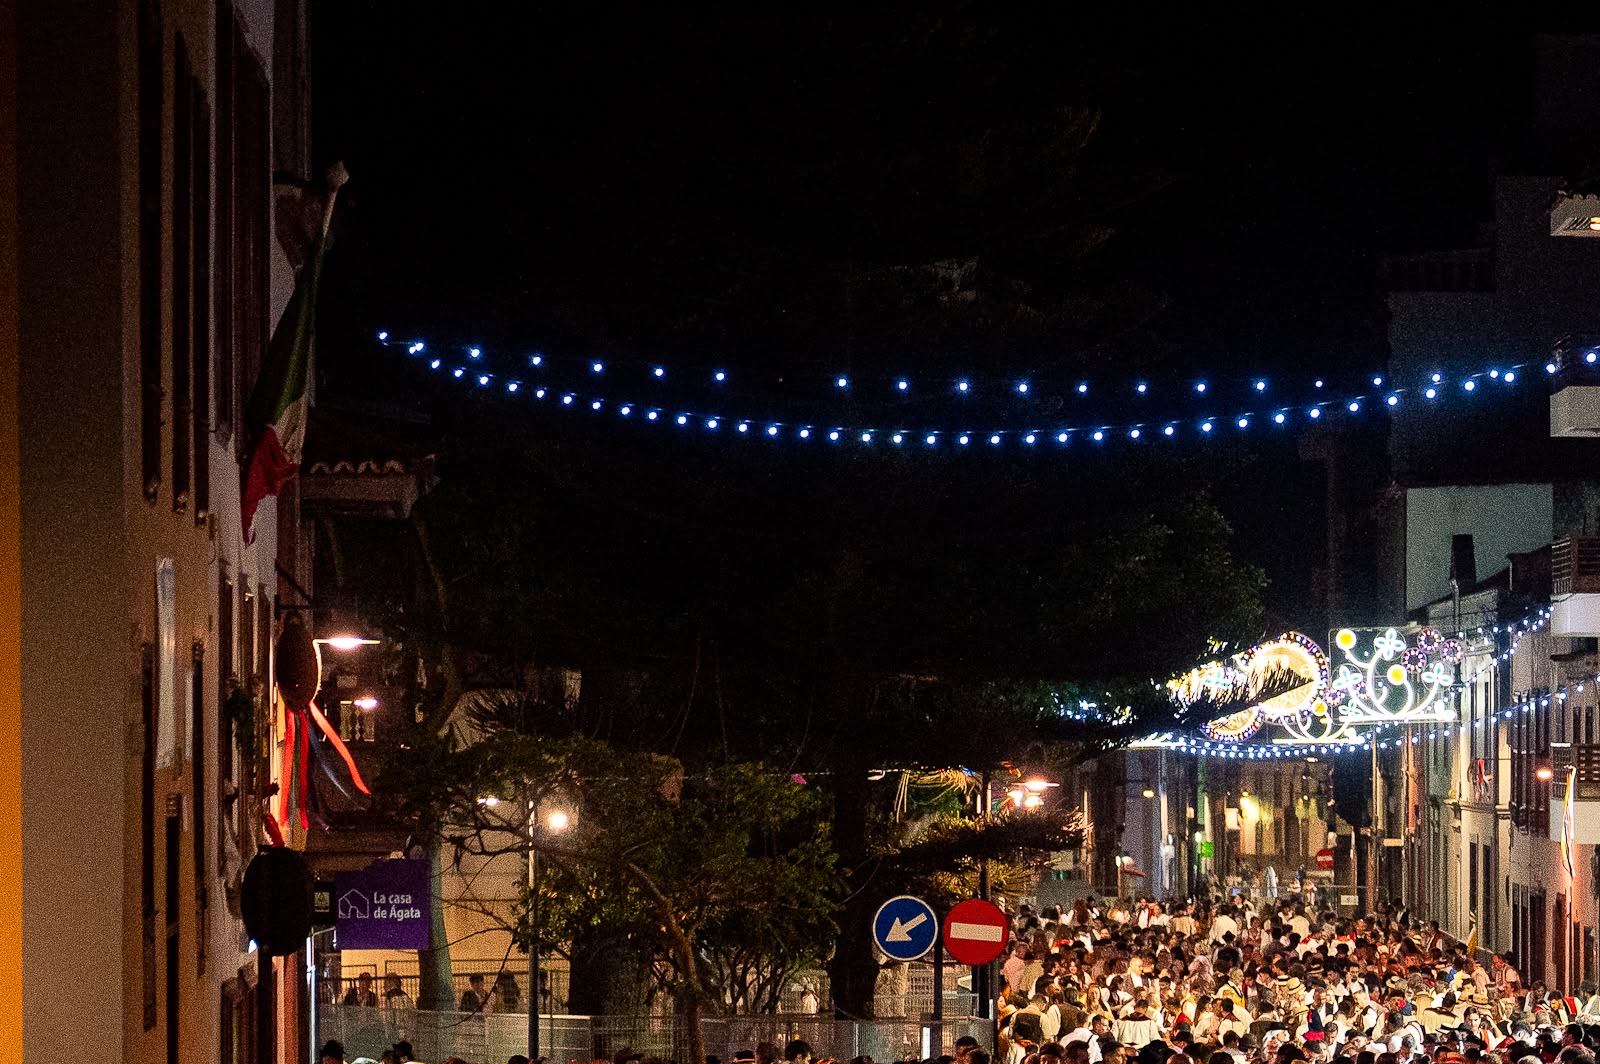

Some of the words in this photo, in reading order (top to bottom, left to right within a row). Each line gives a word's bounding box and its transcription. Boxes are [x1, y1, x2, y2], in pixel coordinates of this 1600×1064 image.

[374, 891, 386, 904] La
[388, 894, 412, 904] casa
[374, 907, 387, 919] de
[389, 905, 421, 921] Ágata
